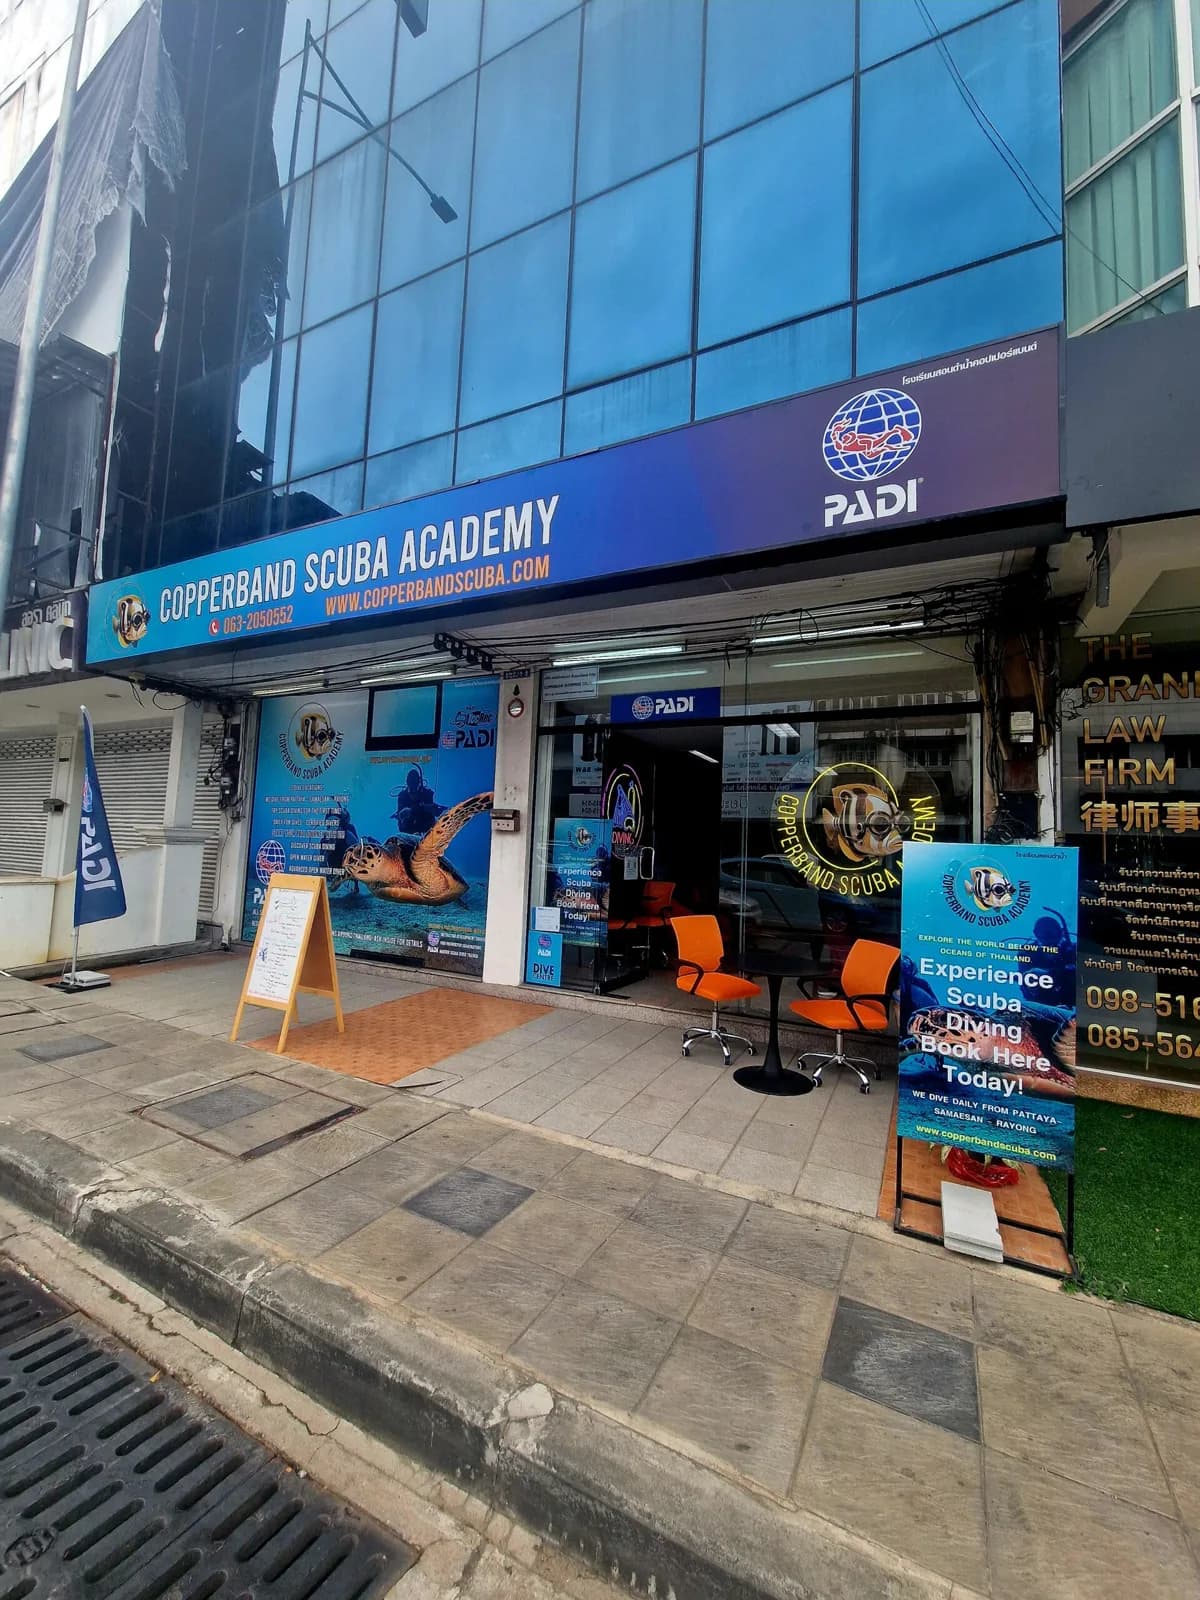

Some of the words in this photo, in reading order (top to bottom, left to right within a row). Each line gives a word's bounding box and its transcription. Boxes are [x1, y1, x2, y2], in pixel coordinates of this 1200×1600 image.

[824, 478, 917, 528] PADI
[160, 559, 296, 623] COPPERBAND
[304, 536, 389, 594] SCUBA
[399, 494, 560, 574] ACADEMY
[325, 555, 551, 616] WWW.COPPERBANDSCUBA.COM
[223, 605, 294, 634] 063-2050552
[1080, 632, 1152, 662] THE
[1082, 671, 1200, 703] GRAN
[655, 696, 694, 714] PADI
[456, 727, 497, 749] PADI
[1083, 714, 1167, 744] LAW
[302, 766, 323, 779] SCUBA
[1084, 757, 1176, 785] FIRM
[1080, 800, 1200, 833] 律师事
[81, 816, 117, 891] PADI
[777, 794, 835, 890] COPPERBAND
[838, 867, 900, 896] SCUBA
[558, 867, 602, 877] Experience
[566, 878, 591, 887] Scuba
[556, 900, 577, 909] Book
[565, 888, 591, 900] Diving
[943, 874, 976, 924] COPPERBAND
[977, 913, 1009, 927] SCUBA
[1010, 880, 1032, 920] ACADEMY
[918, 934, 953, 944] EXPLORE
[957, 938, 972, 946] THE
[975, 939, 1005, 949] WORLD
[1008, 942, 1038, 952] BELOW
[1042, 945, 1059, 954] THE
[940, 948, 972, 957] OCEANS
[975, 951, 988, 959] OF
[533, 962, 555, 976] DIVE
[919, 958, 1054, 989] Experience
[946, 987, 1021, 1013] Scuba
[946, 1011, 1022, 1044] Diving
[921, 1035, 981, 1060] Book
[994, 1046, 1051, 1072] Here
[942, 1064, 1023, 1098] Today!
[912, 1089, 926, 1098] WE
[929, 1092, 949, 1103] DIVE
[952, 1098, 979, 1109] DAILY
[982, 1103, 1009, 1115] FROM
[934, 1107, 983, 1123] SAMAESAN
[996, 1119, 1037, 1134] RAYONG
[916, 1124, 1056, 1161] www.copperbandscuba.com
